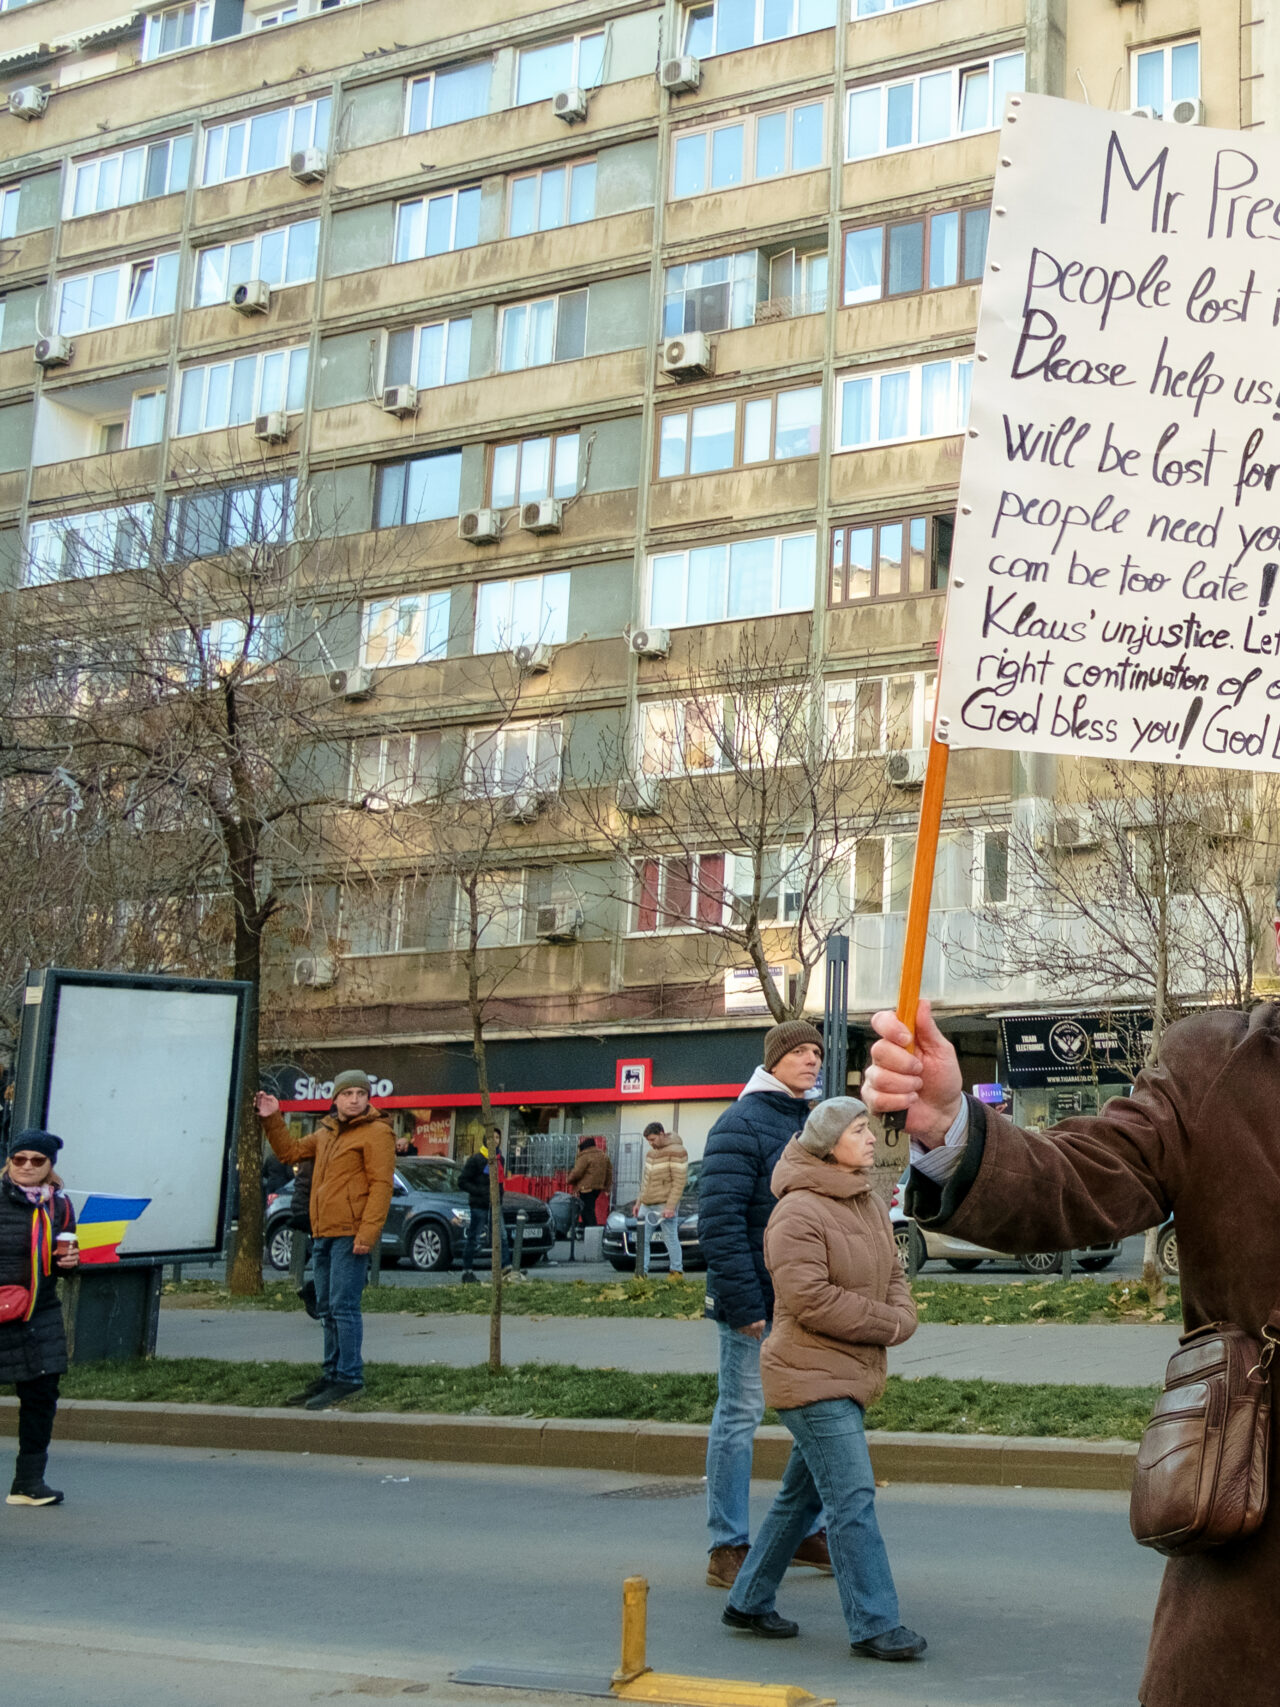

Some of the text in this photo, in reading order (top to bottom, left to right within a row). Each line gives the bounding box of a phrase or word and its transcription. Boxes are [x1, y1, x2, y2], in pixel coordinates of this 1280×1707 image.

[1100, 130, 1185, 234] Mr.
[1186, 266, 1262, 324] lost
[1011, 308, 1137, 387] Please
[1149, 336, 1224, 418] help
[1098, 422, 1142, 476] be
[1153, 422, 1228, 487] lost
[991, 489, 1131, 556] people
[1146, 506, 1224, 548] need
[988, 554, 1049, 583] can
[1067, 550, 1111, 588] be
[1119, 553, 1172, 595] too
[1182, 560, 1280, 617] late!
[982, 585, 1096, 643] Klaus'
[1101, 612, 1234, 655] unjustice.
[976, 647, 1055, 697] right
[1063, 653, 1210, 693] continuation
[1216, 667, 1263, 707] of
[960, 687, 1043, 734] God
[1051, 694, 1118, 743] bless
[1129, 696, 1204, 760] you!
[1202, 704, 1271, 756] God
